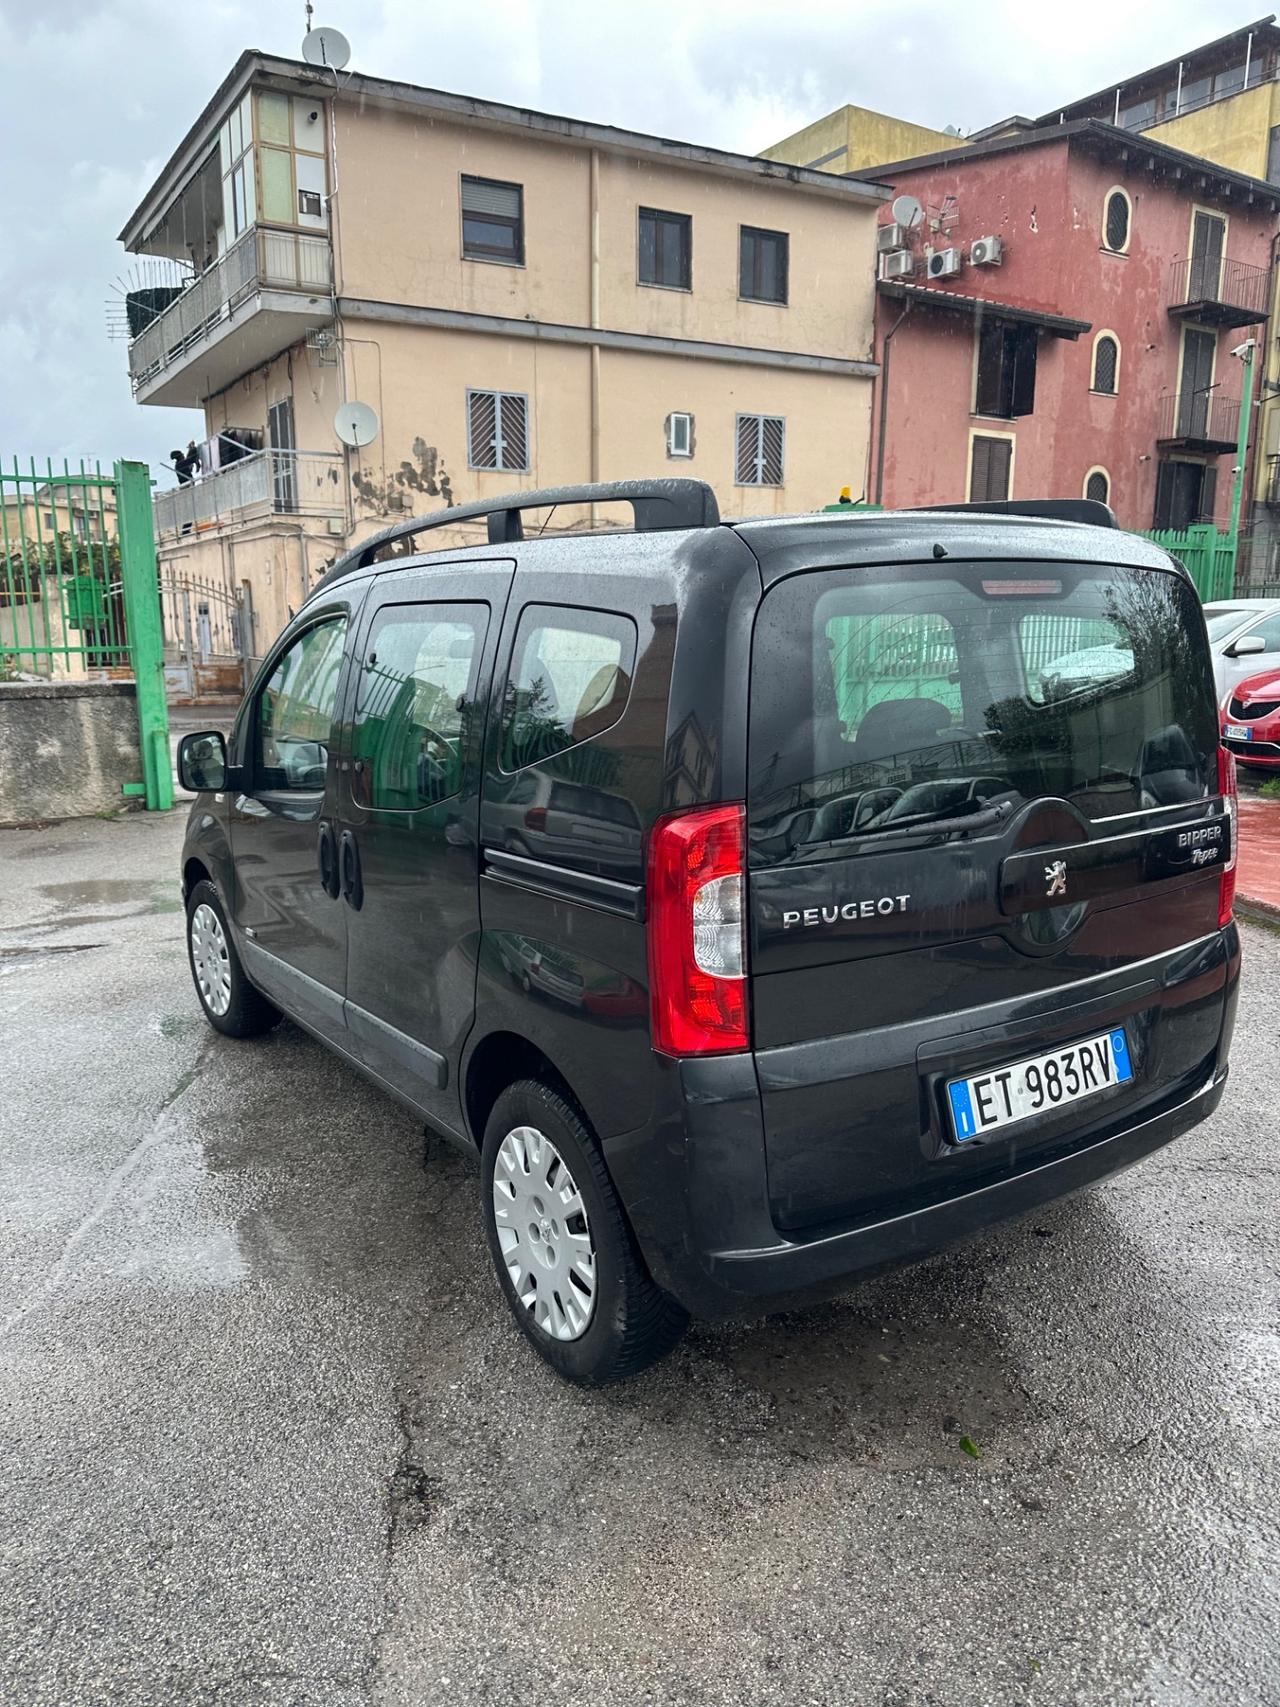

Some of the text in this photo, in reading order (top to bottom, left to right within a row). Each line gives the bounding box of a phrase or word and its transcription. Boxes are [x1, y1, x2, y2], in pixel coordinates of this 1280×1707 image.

[1178, 826, 1221, 847] BIPPER
[783, 895, 911, 929] PEUGEOT
[973, 1039, 1110, 1126] ET 983RV
